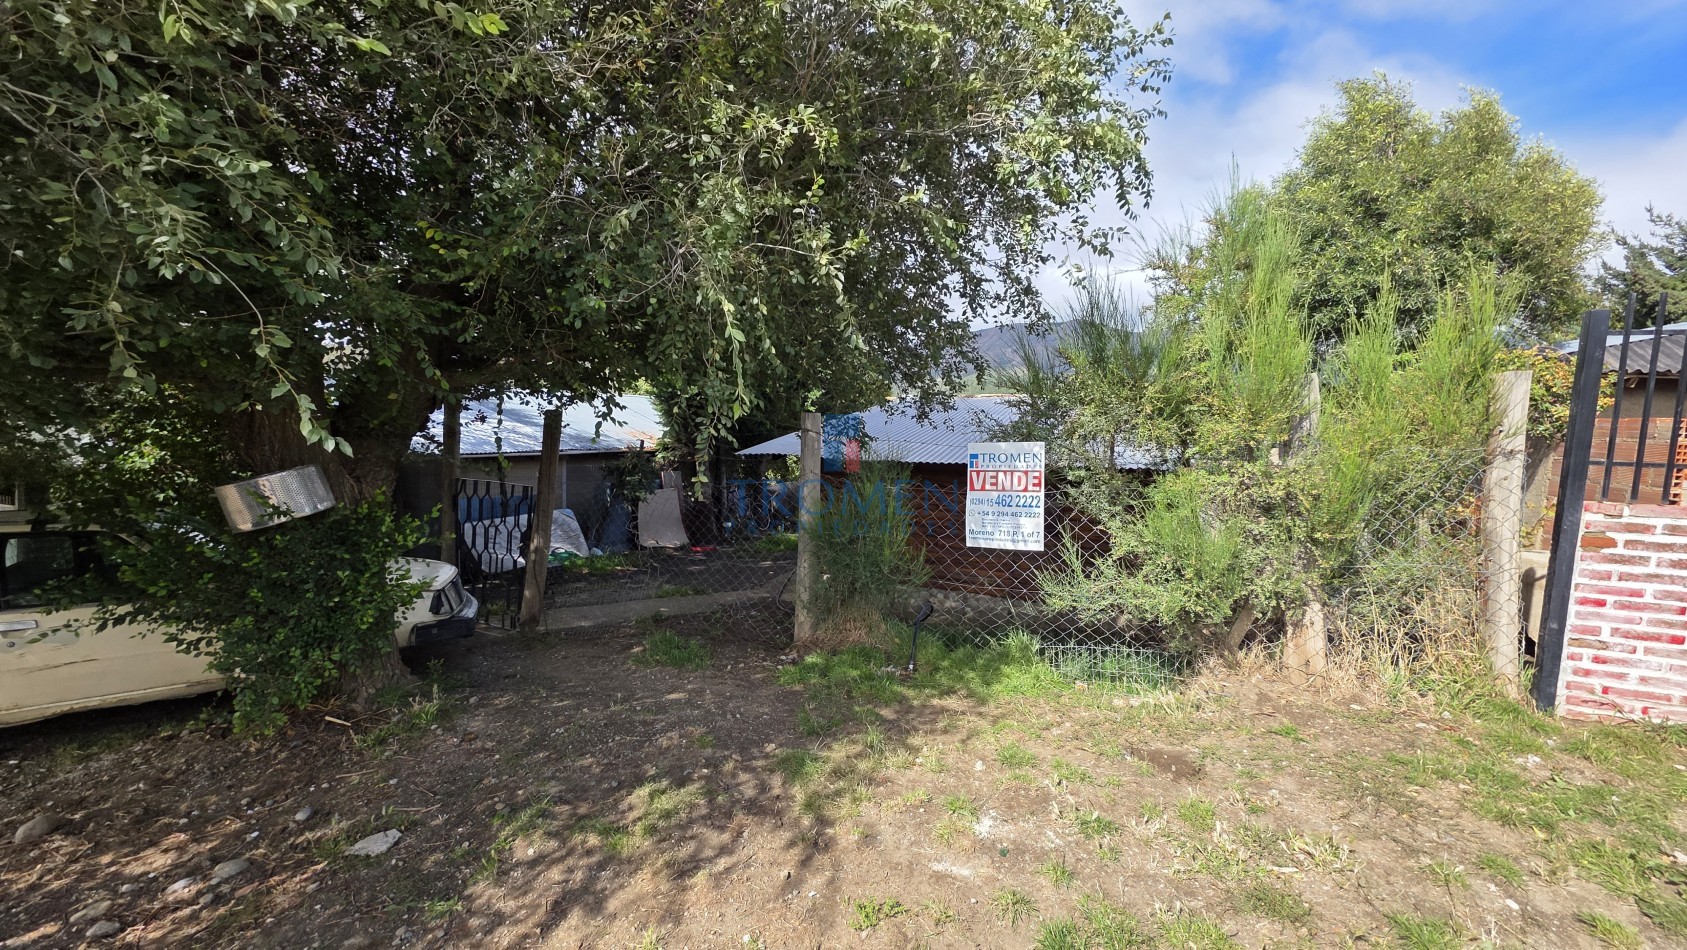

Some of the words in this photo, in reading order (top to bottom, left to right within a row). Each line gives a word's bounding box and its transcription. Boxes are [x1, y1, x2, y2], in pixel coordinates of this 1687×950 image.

[980, 452, 1042, 463] TROMEN
[971, 471, 1040, 490] VENDE
[995, 493, 1013, 508] 462
[1015, 494, 1041, 508] 2222
[968, 528, 995, 537] Moreno
[1012, 530, 1019, 538] P.
